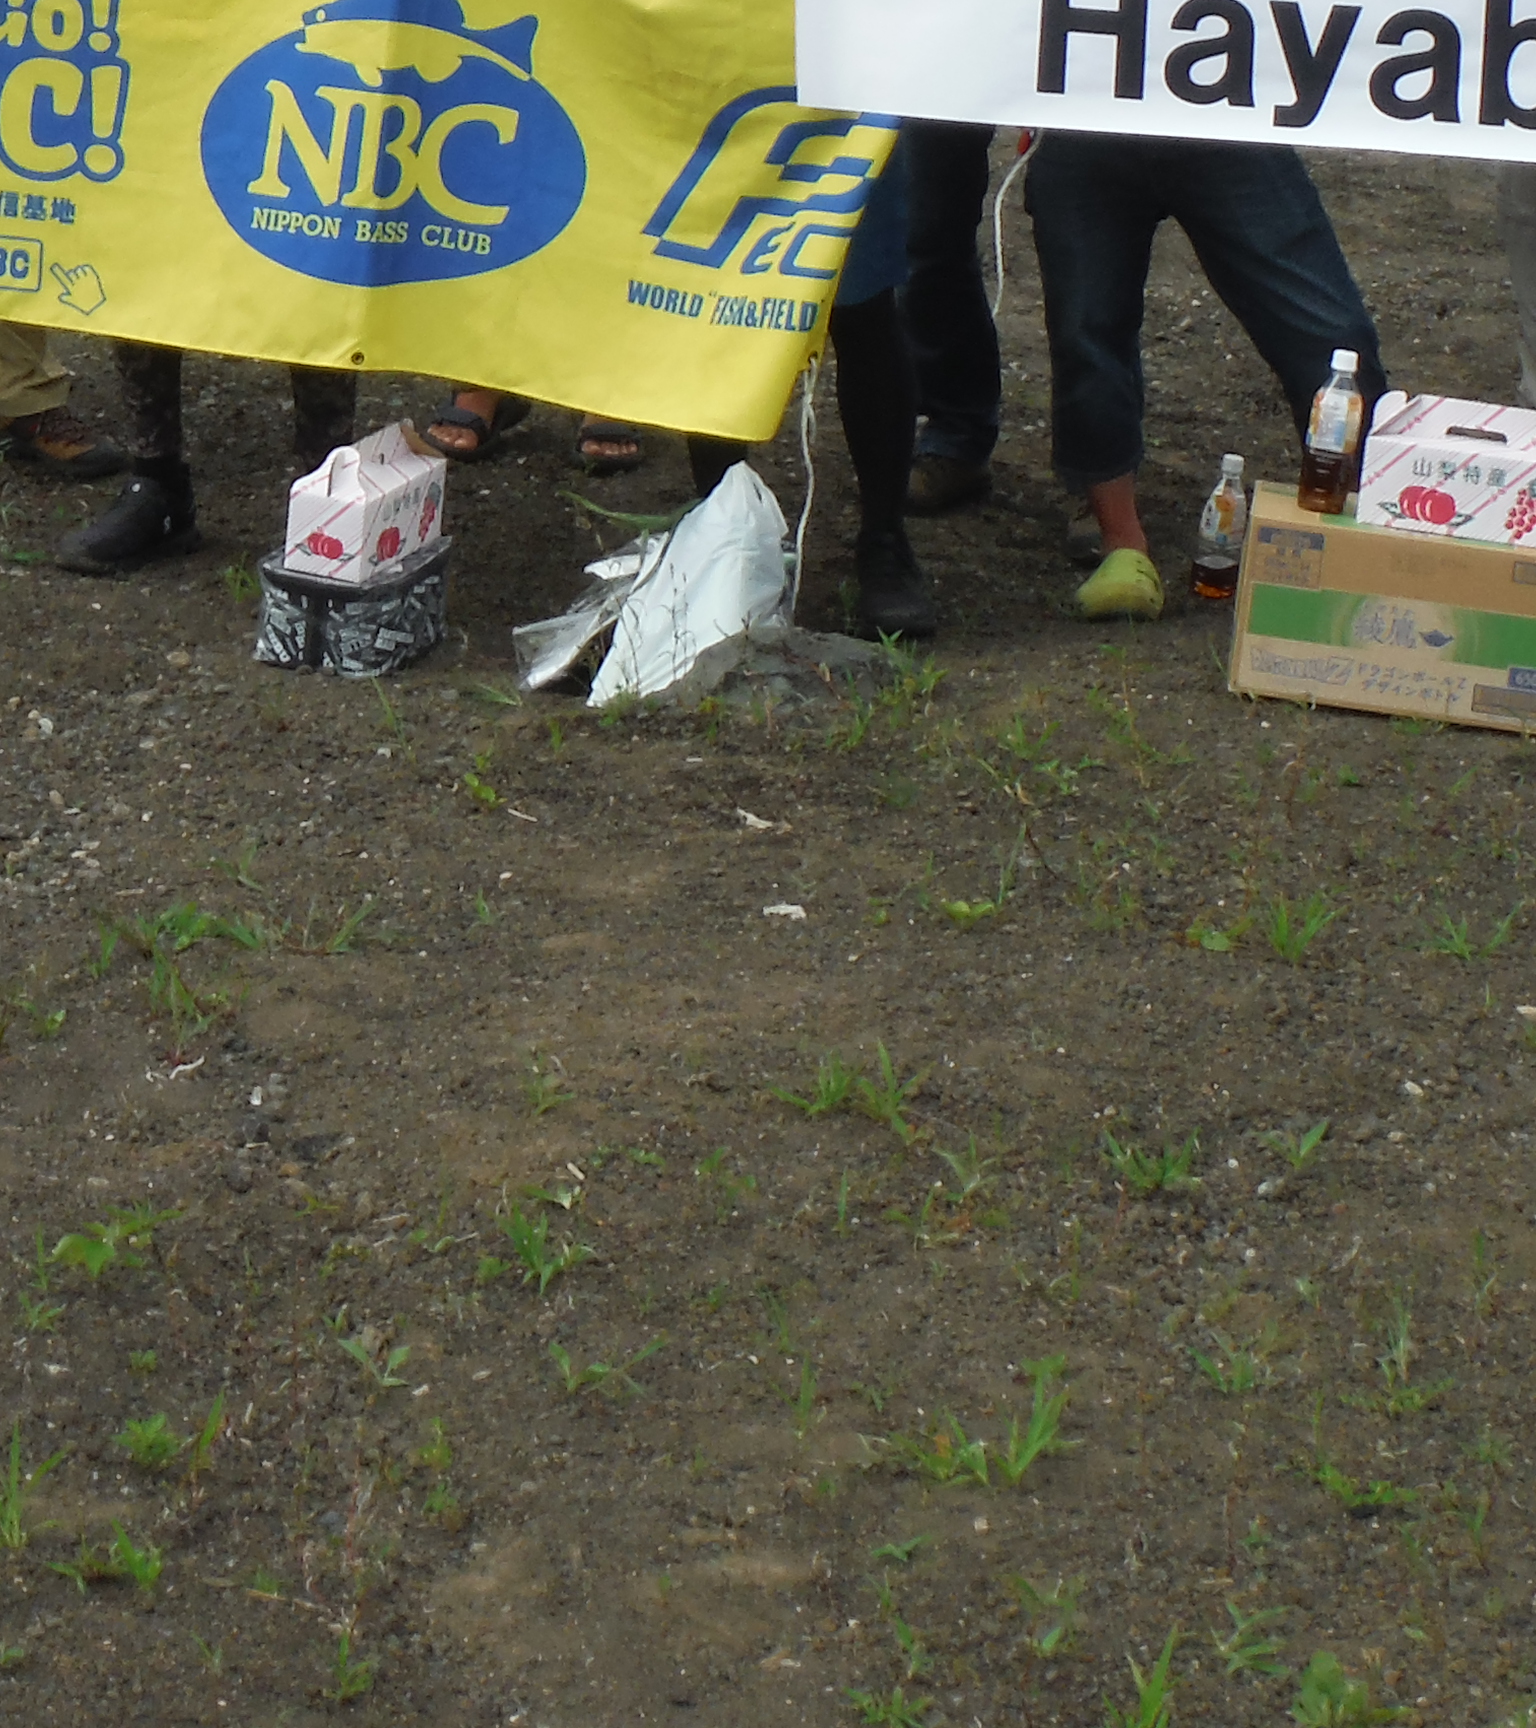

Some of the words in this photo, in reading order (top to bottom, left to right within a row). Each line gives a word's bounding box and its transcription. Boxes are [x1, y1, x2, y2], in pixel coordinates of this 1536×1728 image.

[247, 79, 519, 225] NBC
[251, 207, 342, 239] NIPPON
[355, 220, 409, 243] BASS
[421, 225, 492, 255] CLUB
[627, 279, 704, 318] WORLD
